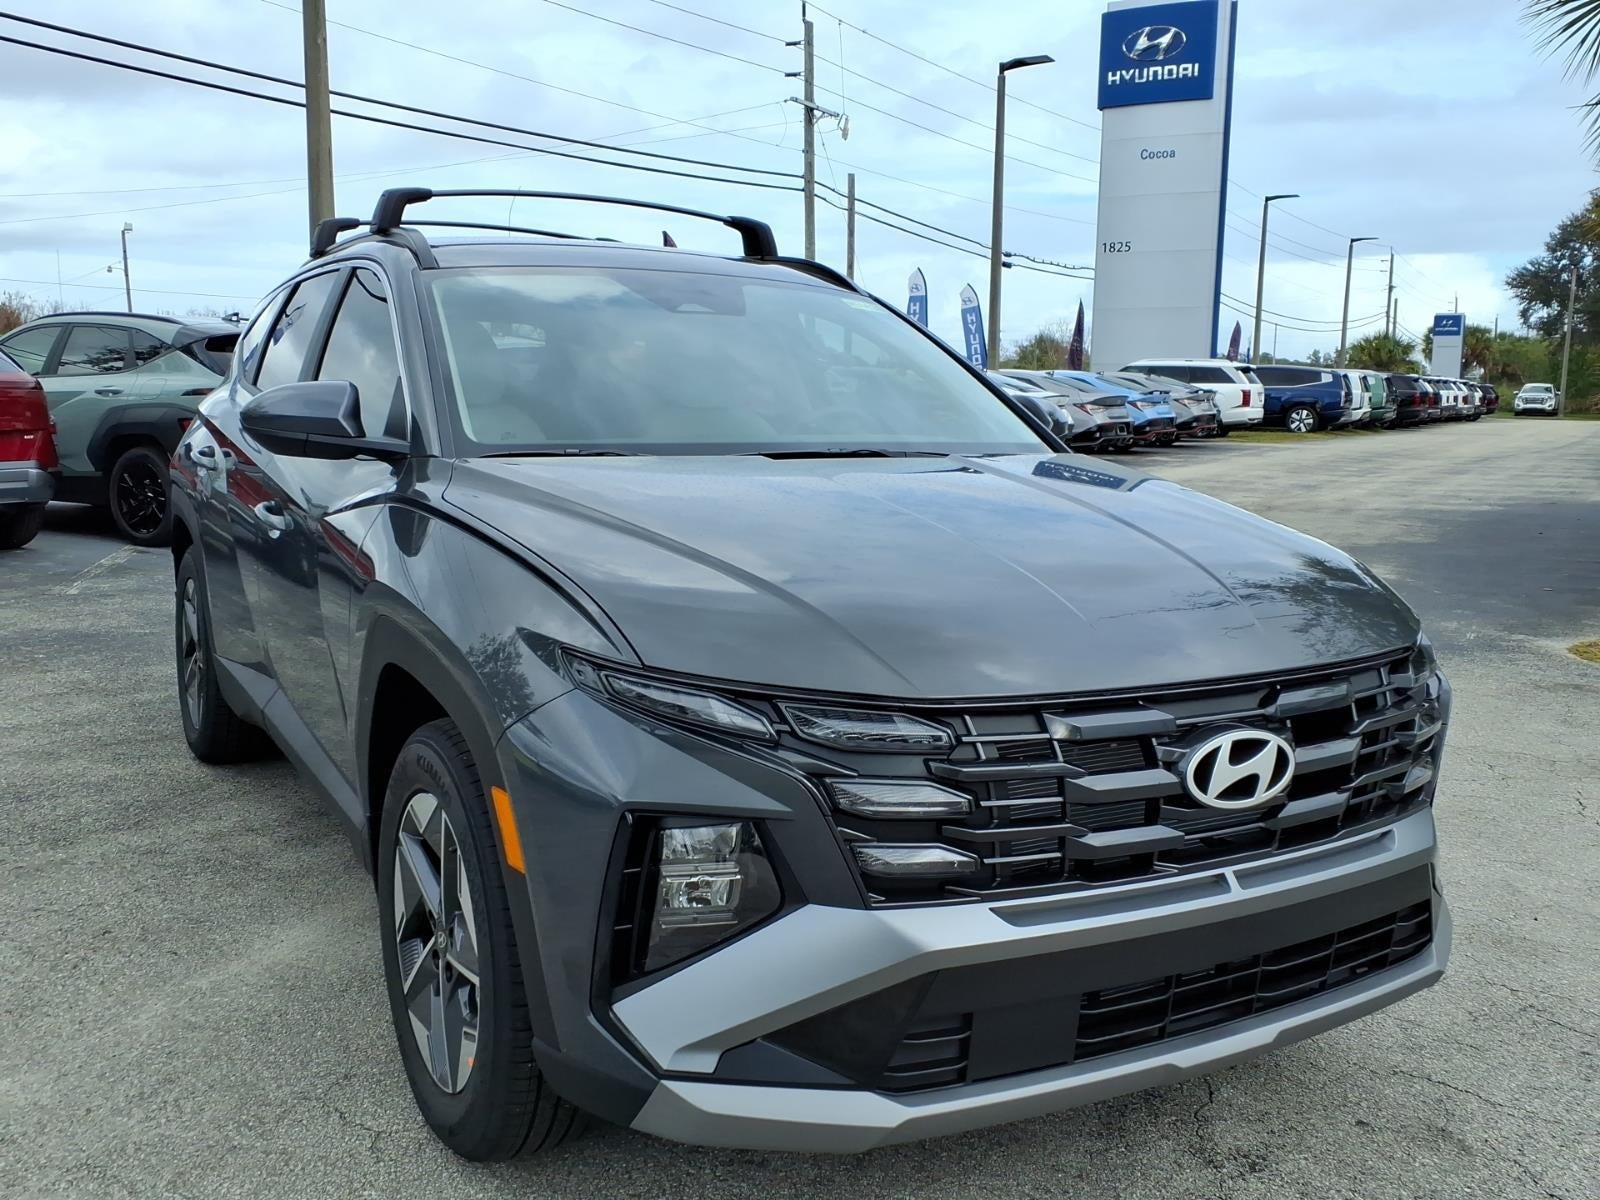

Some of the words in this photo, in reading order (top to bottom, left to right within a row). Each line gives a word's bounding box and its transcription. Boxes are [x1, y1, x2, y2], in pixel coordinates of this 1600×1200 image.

[1107, 63, 1199, 85] HYUNDAI
[1140, 149, 1176, 160] Cocoa
[1102, 241, 1131, 253] 1825
